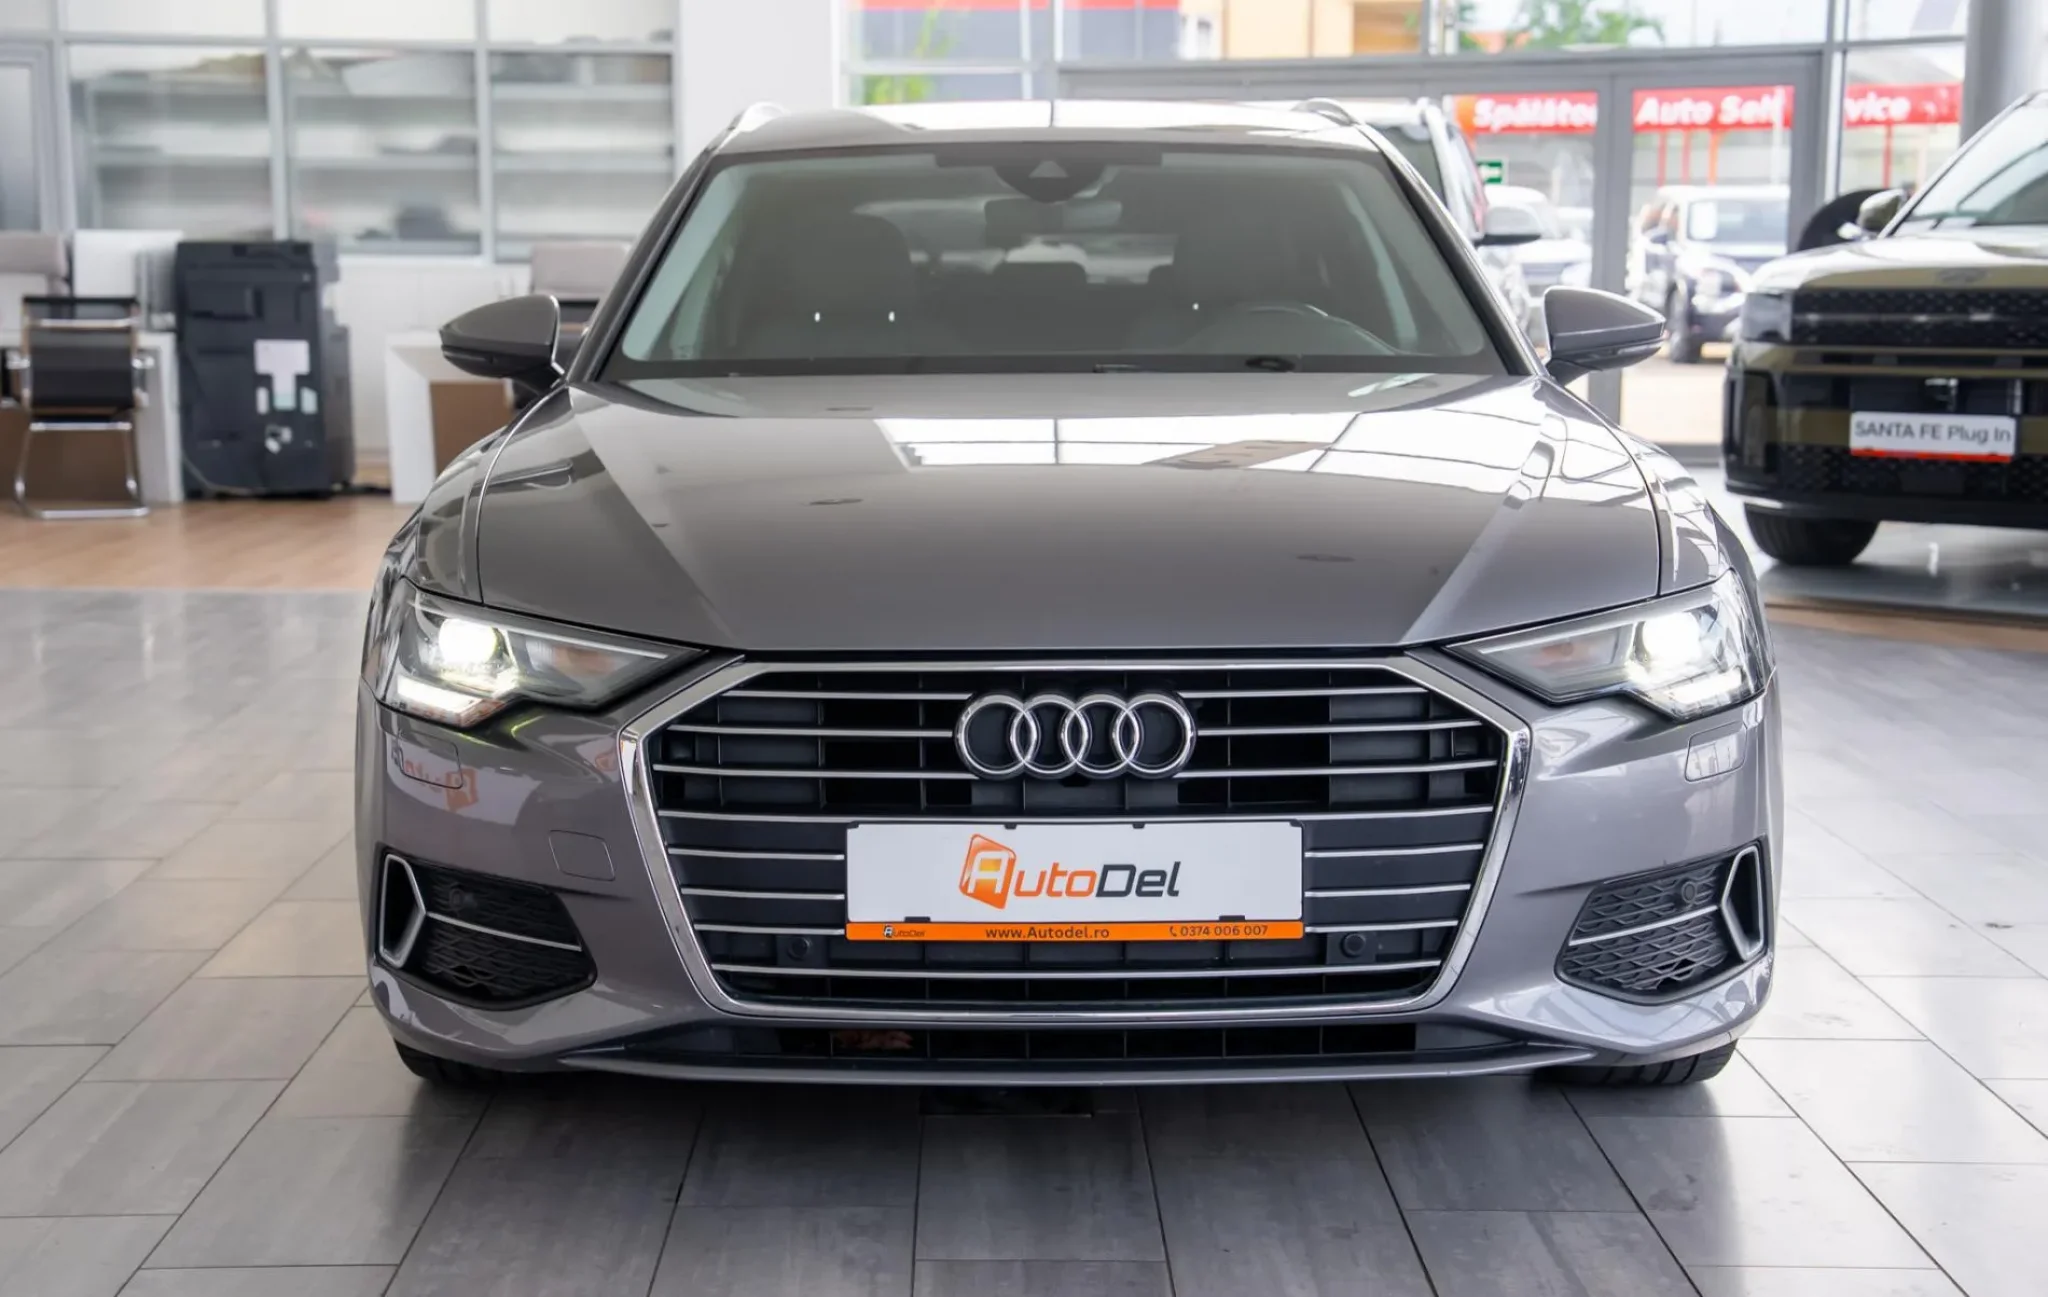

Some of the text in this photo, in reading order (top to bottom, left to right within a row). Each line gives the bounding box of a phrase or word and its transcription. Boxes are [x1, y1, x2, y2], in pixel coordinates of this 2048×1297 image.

[1634, 97, 1713, 126] Auto
[1855, 420, 2011, 446] SANTA FE Plug In
[963, 845, 1181, 899] AutoDel
[883, 925, 925, 938] AutoDel
[985, 926, 1110, 939] www.Autodel.ro
[1180, 925, 1268, 937] 0374 006 007
